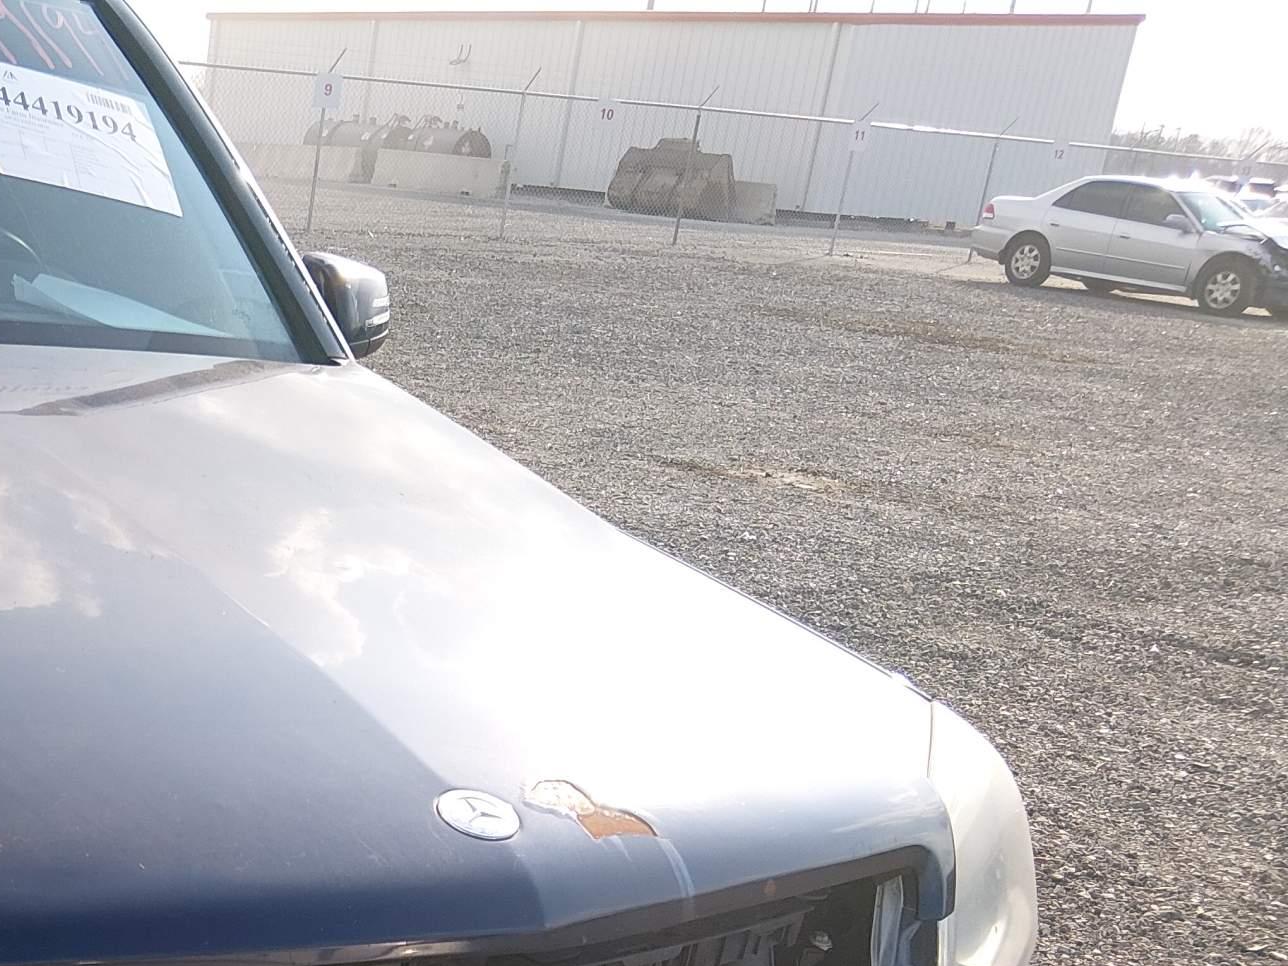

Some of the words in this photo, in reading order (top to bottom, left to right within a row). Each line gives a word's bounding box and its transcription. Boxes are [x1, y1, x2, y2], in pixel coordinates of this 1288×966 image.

[323, 83, 333, 97] 9
[600, 108, 614, 121] 10
[855, 129, 866, 141] 11
[1054, 149, 1065, 160] 12
